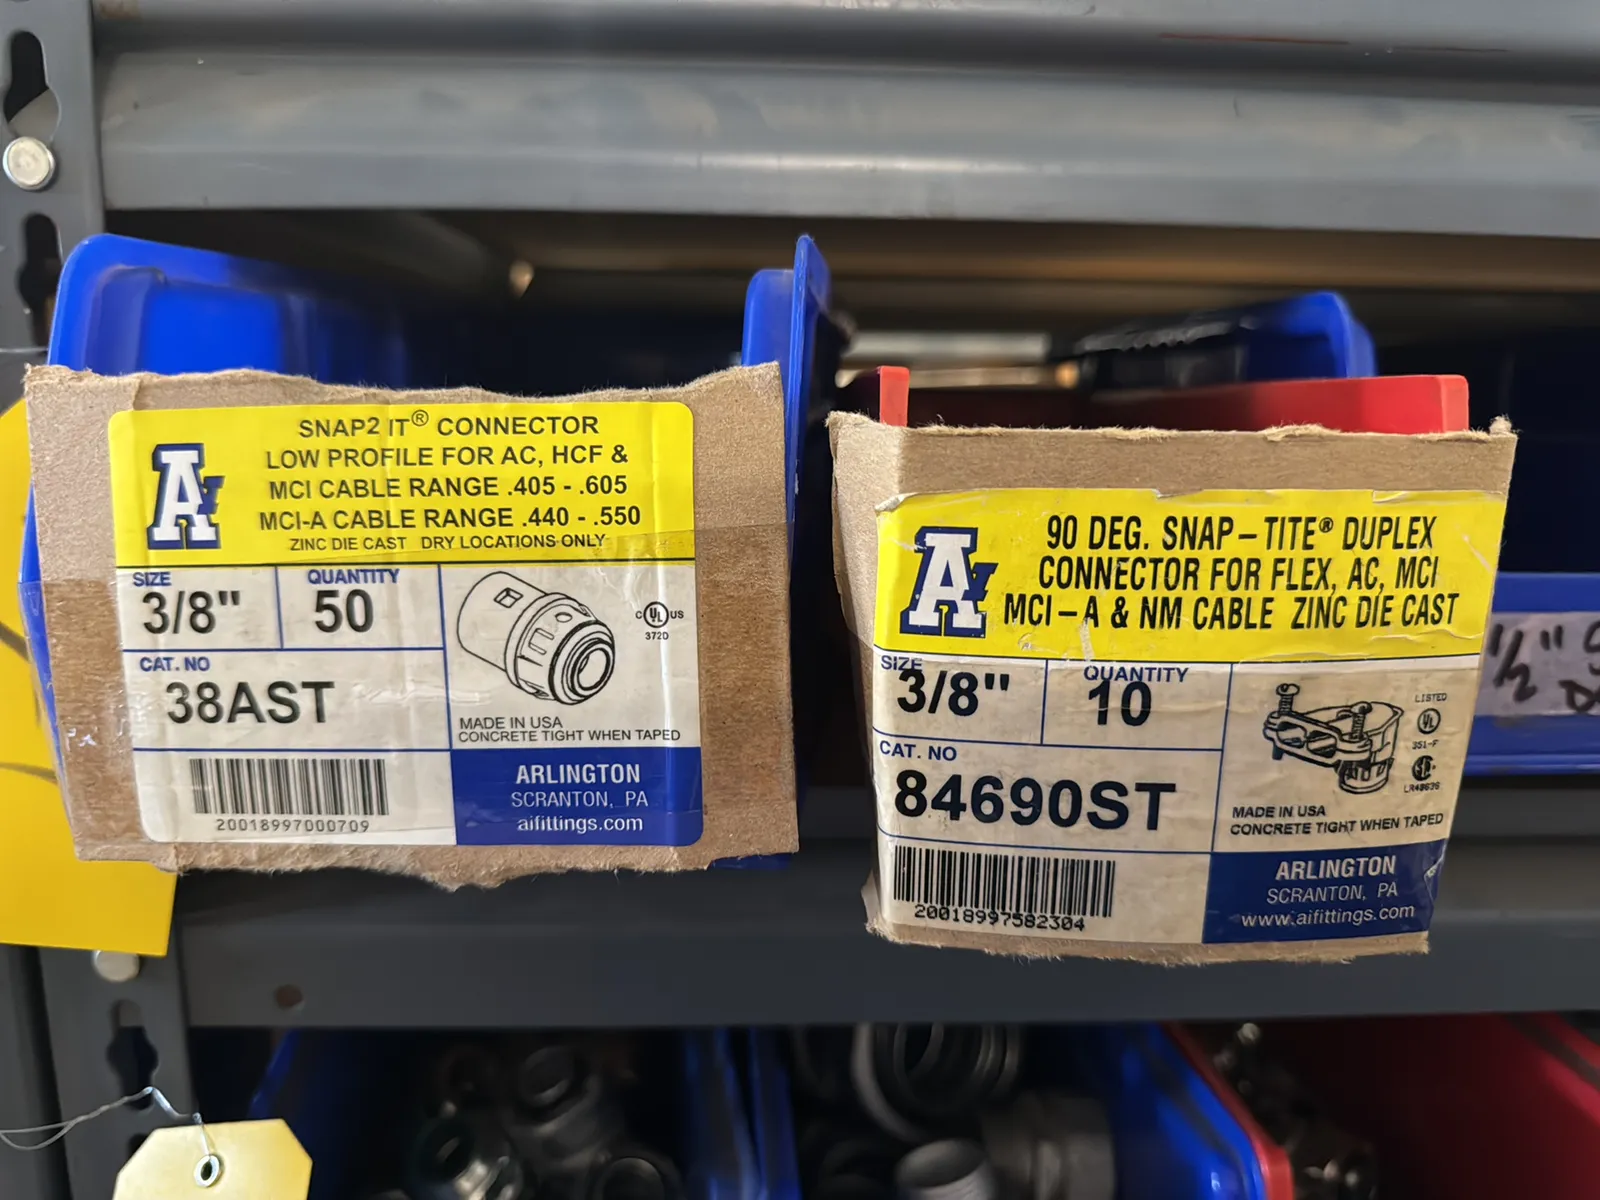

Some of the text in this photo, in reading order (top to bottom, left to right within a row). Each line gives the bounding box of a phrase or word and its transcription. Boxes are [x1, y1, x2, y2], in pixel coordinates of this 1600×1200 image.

[299, 417, 380, 438] SNAP2
[437, 416, 599, 436] CONNECTOR
[267, 444, 628, 469] LOW PROFILE FOR AC, HCF &
[270, 480, 311, 500] MCI
[319, 478, 400, 499] CABLE
[410, 477, 499, 497] RANGE
[507, 476, 556, 496] .405
[579, 475, 627, 495] .605
[260, 511, 327, 531] MCI-A
[334, 509, 415, 529] CABLE
[425, 508, 513, 528] RANGE
[522, 507, 569, 527] .440
[593, 505, 641, 526] .550
[290, 533, 605, 551] ZINC DIE CAST DRY LOCATIONS ONLY
[1047, 514, 1078, 550] 90
[1088, 515, 1149, 550] DEG.
[1342, 515, 1437, 550] DUPLEX
[133, 571, 172, 587] SIZE
[308, 569, 400, 585] QUANTITY
[1039, 555, 1439, 597] CONNECTOR FOR FLEX, AC, MCI
[142, 590, 240, 634] 3/8"
[315, 588, 374, 633] 50
[1110, 596, 1129, 628] &
[1139, 596, 1183, 630] NM
[1193, 596, 1275, 630] CABLE
[1290, 595, 1347, 630] ZINC
[1355, 594, 1394, 628] DIE
[1401, 592, 1460, 627] CAST
[140, 656, 210, 672] CAT. NO
[881, 655, 923, 673] SIZE
[1083, 665, 1189, 683] QUANTITY
[166, 681, 335, 724] 38AST
[897, 669, 1010, 717] 3/8"
[1088, 681, 1152, 727] 10
[1414, 692, 1447, 703] LISTED
[460, 716, 563, 730] MADE IN USA
[458, 729, 681, 743] CONCRETE TIGHT WHEN TAPED
[879, 740, 957, 762] CAT. NO
[516, 763, 640, 785] ARLINGTON
[511, 791, 648, 809] SCRANTON, PA
[894, 769, 1177, 831] 84690ST
[1232, 805, 1326, 819] MADE IN USA
[216, 818, 370, 833] 20018997000709
[517, 815, 643, 834] aifittings.com
[1230, 813, 1444, 836] CONCRETE TIGHT WHEN TAPED
[1275, 855, 1397, 881] ARLINGTON
[1266, 881, 1398, 904] SCRANTON, PA
[914, 903, 1085, 931] 20018997582304
[1241, 904, 1415, 928] www.aifittings.com
